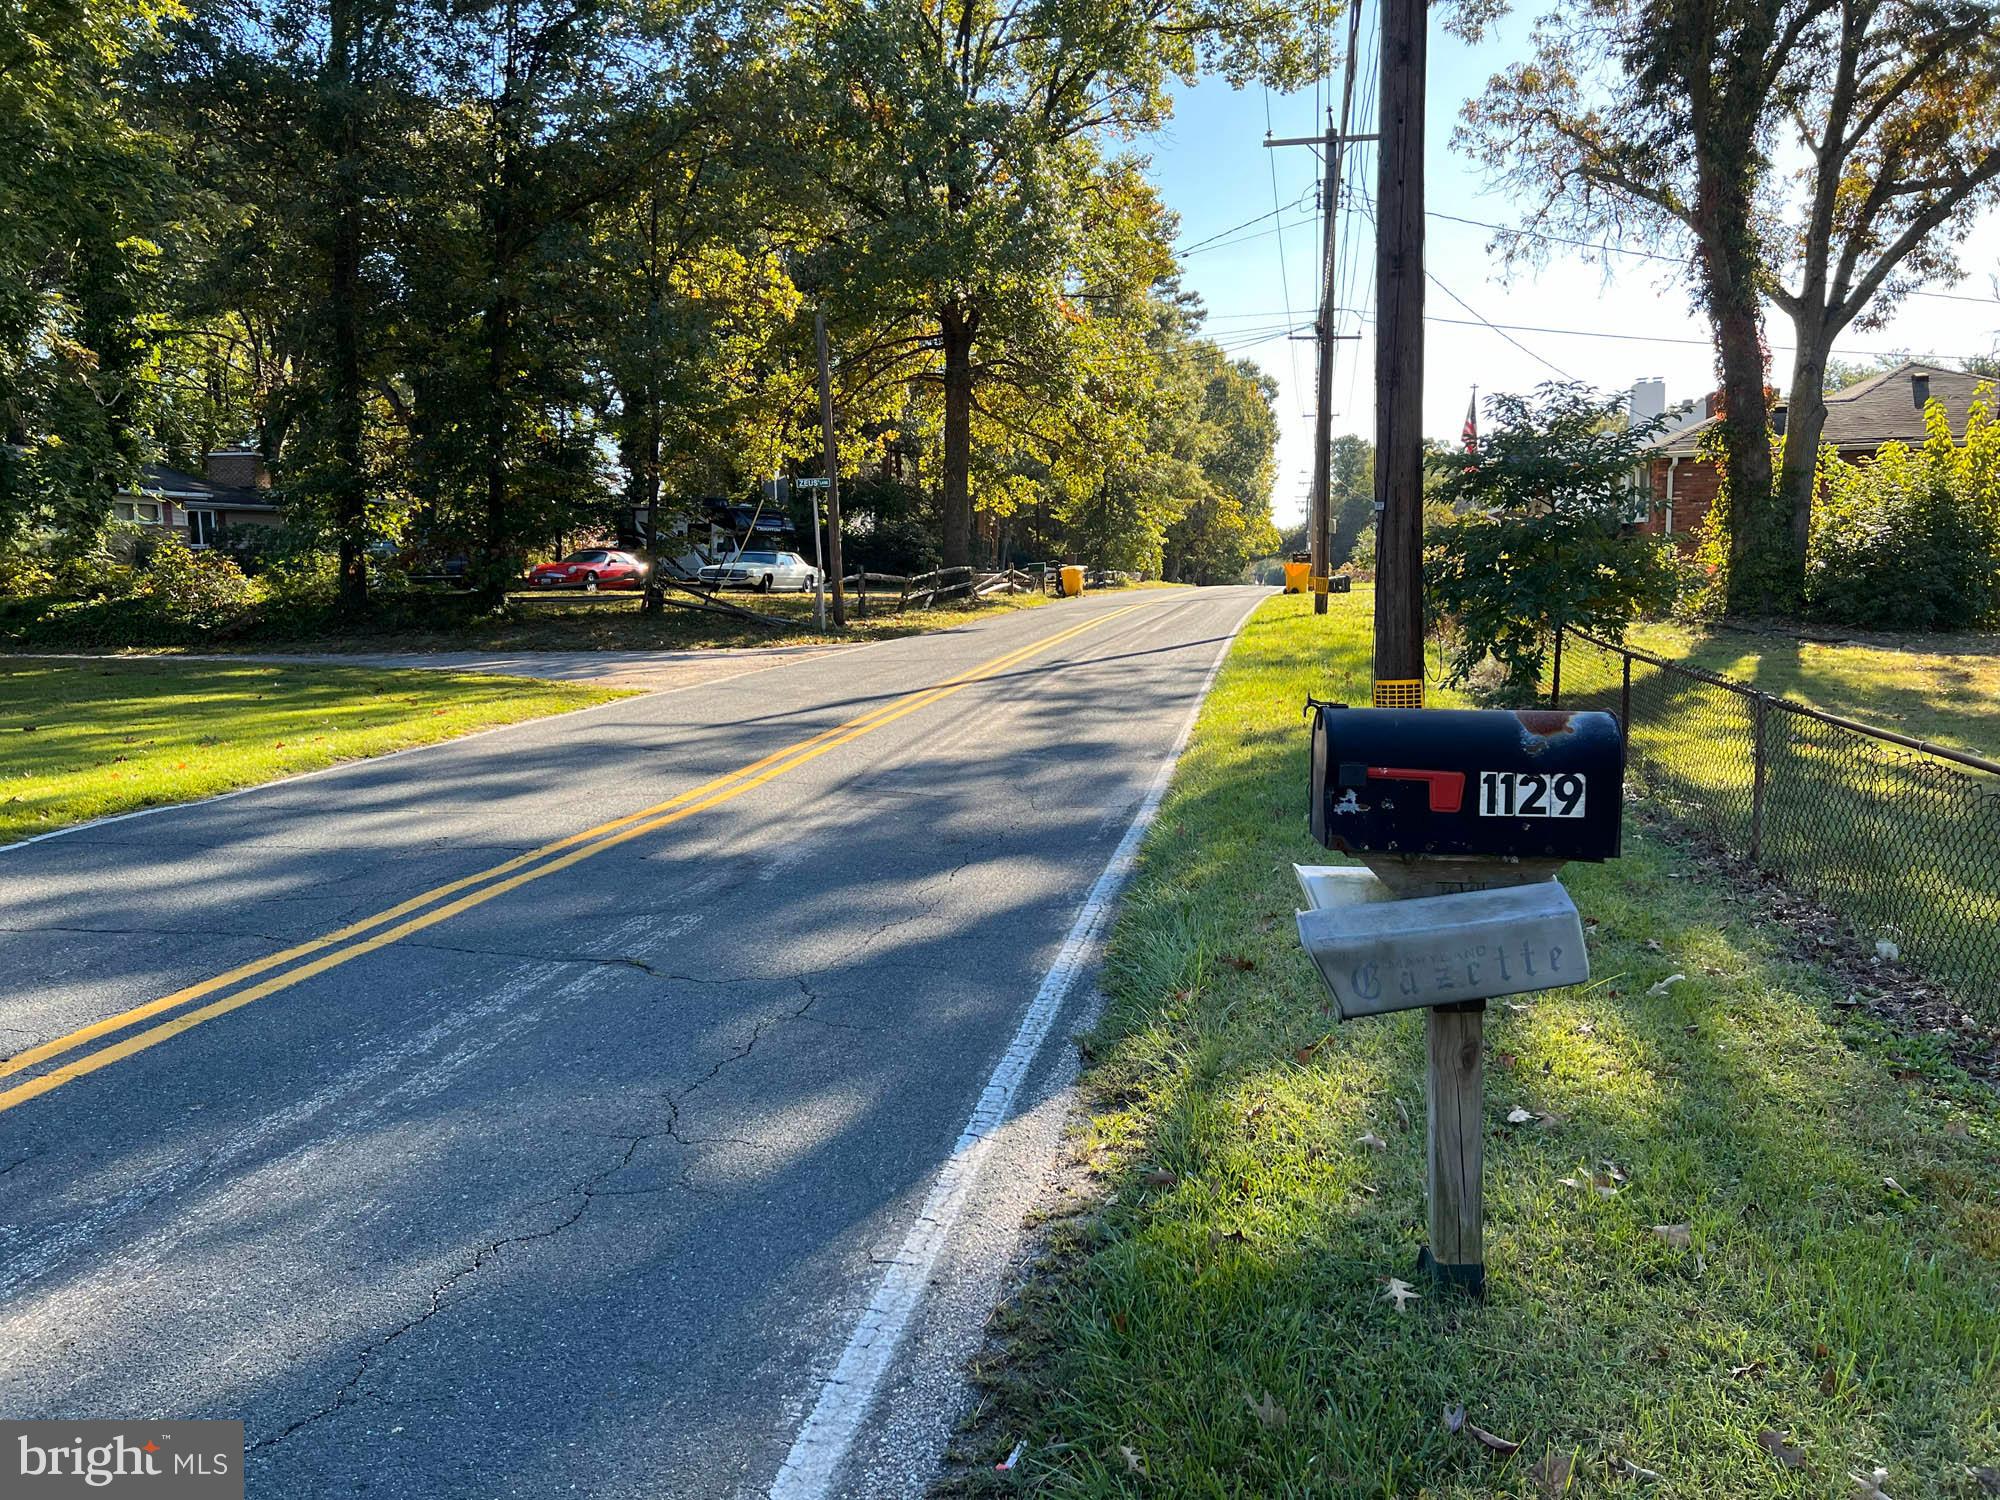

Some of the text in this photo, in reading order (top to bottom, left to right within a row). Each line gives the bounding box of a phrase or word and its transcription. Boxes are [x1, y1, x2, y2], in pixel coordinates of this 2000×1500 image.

[799, 479, 818, 487] ZEUS
[1481, 772, 1585, 816] 1129
[1351, 939, 1562, 999] Gazette
